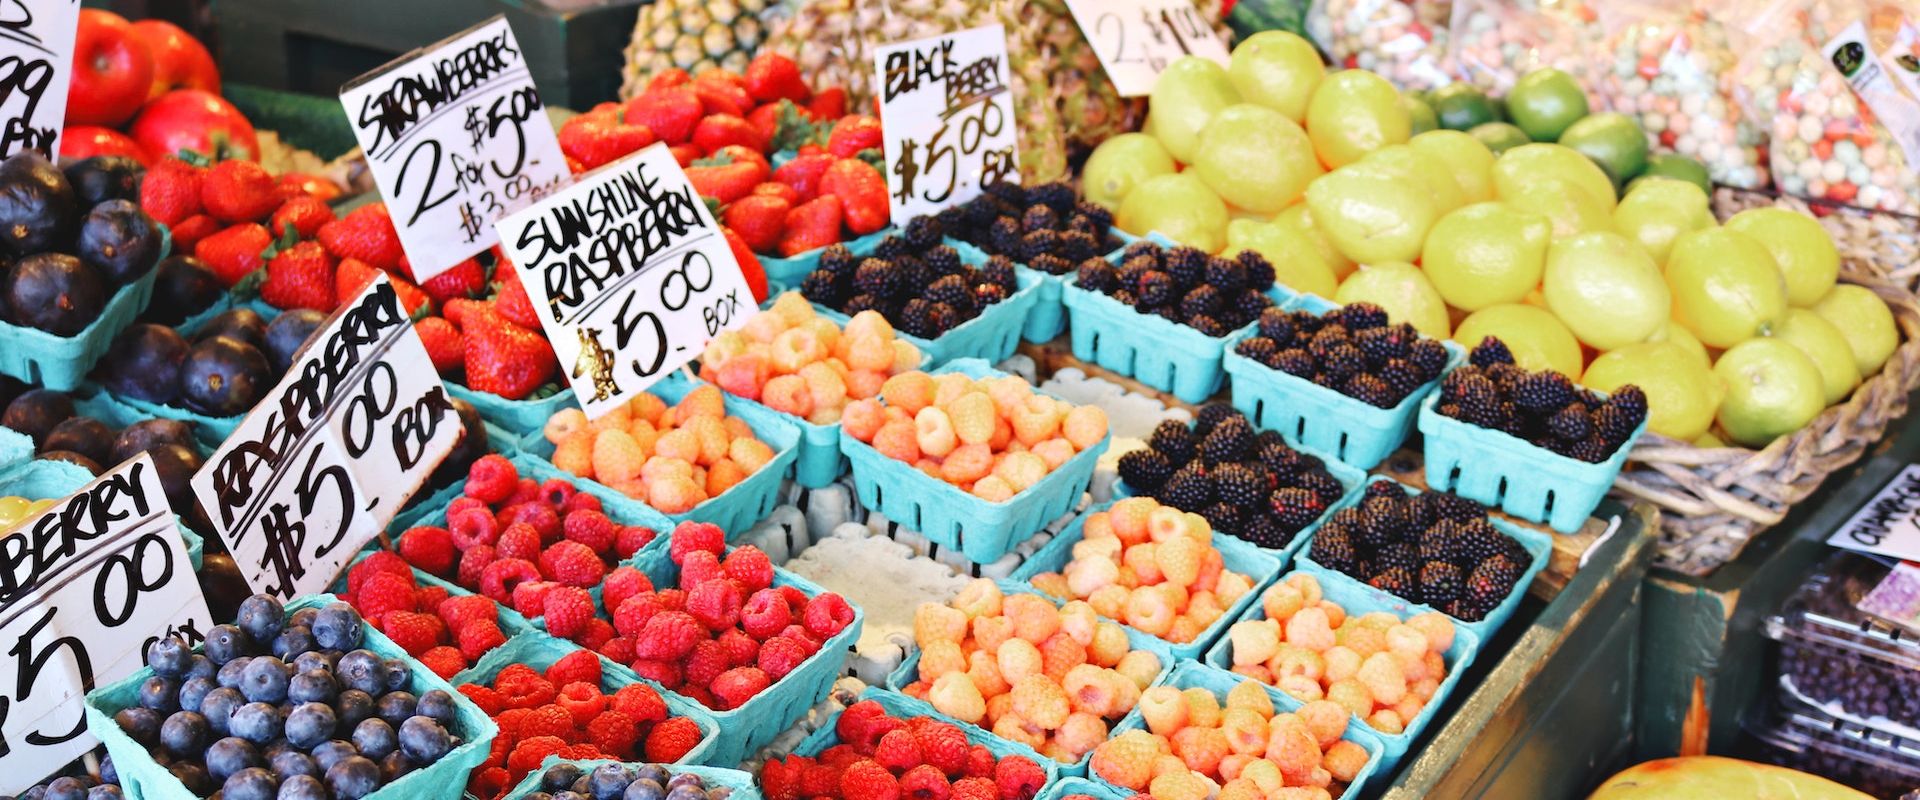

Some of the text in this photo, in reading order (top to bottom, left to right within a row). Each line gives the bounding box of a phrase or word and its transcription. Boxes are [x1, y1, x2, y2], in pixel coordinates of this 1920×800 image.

[358, 29, 518, 157] STRAWBERRIES
[885, 40, 958, 104] BLACK
[945, 54, 1000, 109] BERRY
[394, 139, 459, 228] 2
[451, 152, 486, 193] for
[516, 162, 660, 270] SUNSHINE
[543, 184, 706, 323] RASPBERRY
[702, 288, 744, 337] BOX
[212, 281, 401, 531] RASPBERRY
[391, 385, 455, 473] BOX
